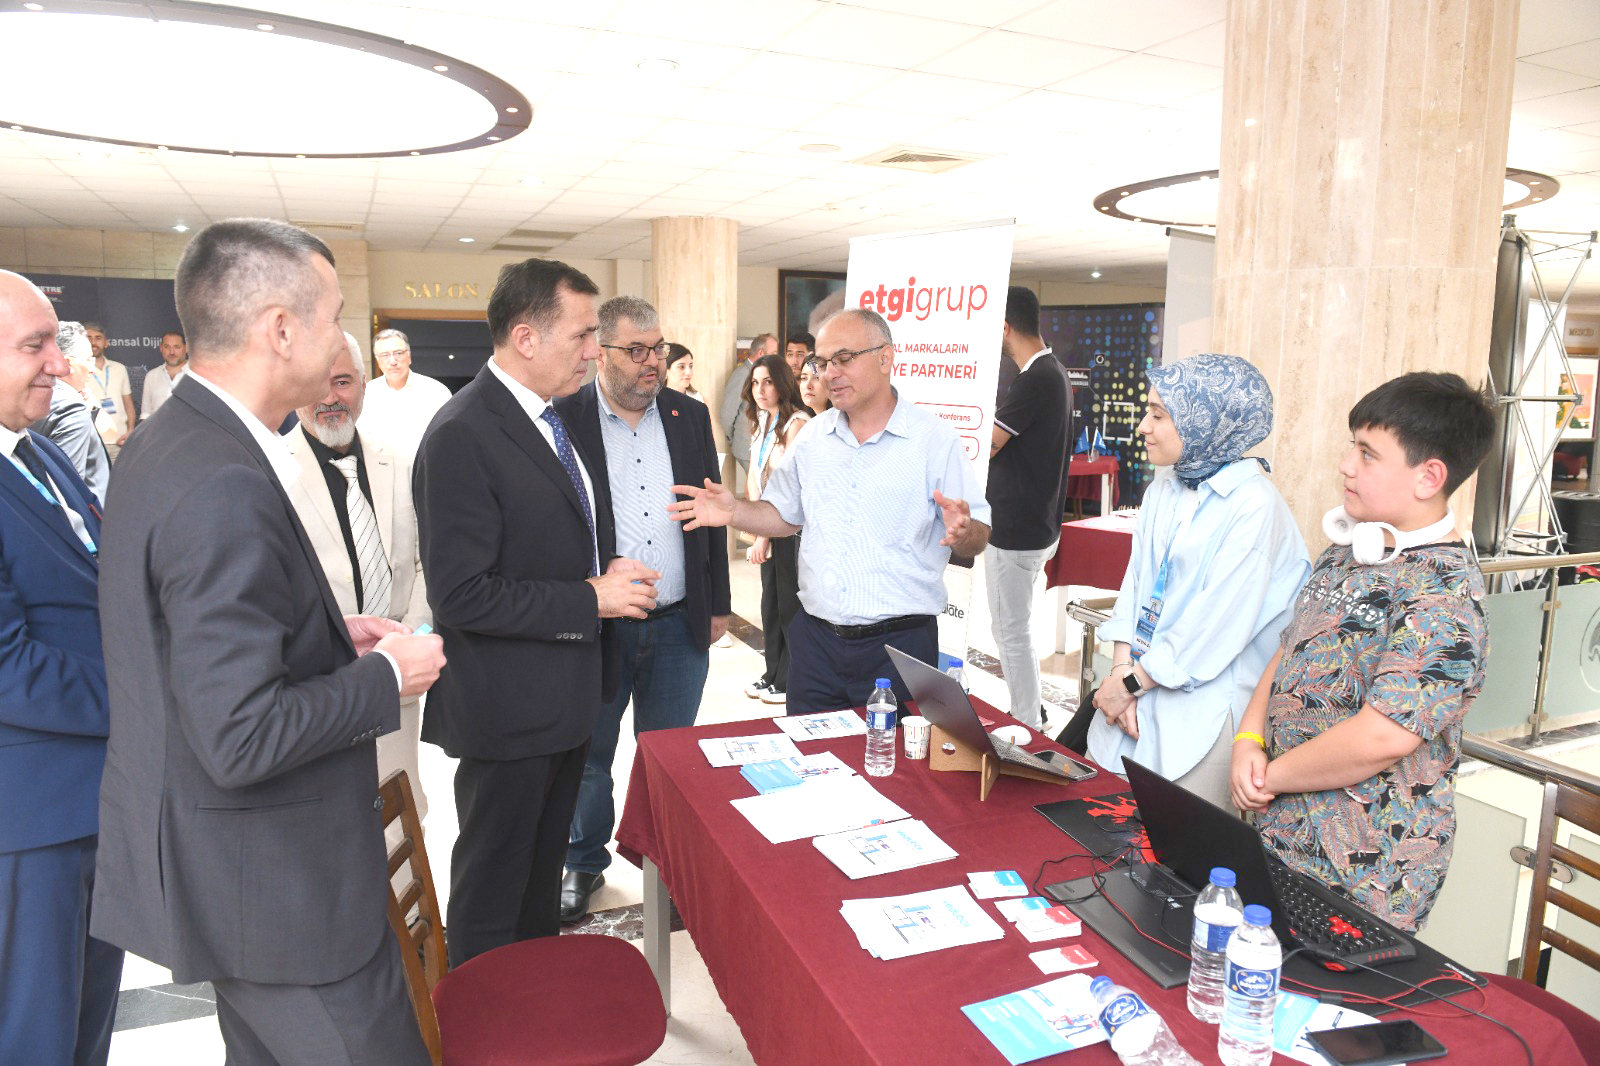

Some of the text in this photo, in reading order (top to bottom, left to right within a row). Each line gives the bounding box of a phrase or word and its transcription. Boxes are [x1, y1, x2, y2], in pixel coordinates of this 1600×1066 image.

[404, 282, 478, 299] SALON
[859, 276, 988, 322] etgigrup
[893, 361, 977, 379] YE PARTNERİ
[939, 413, 970, 421] Konferans
